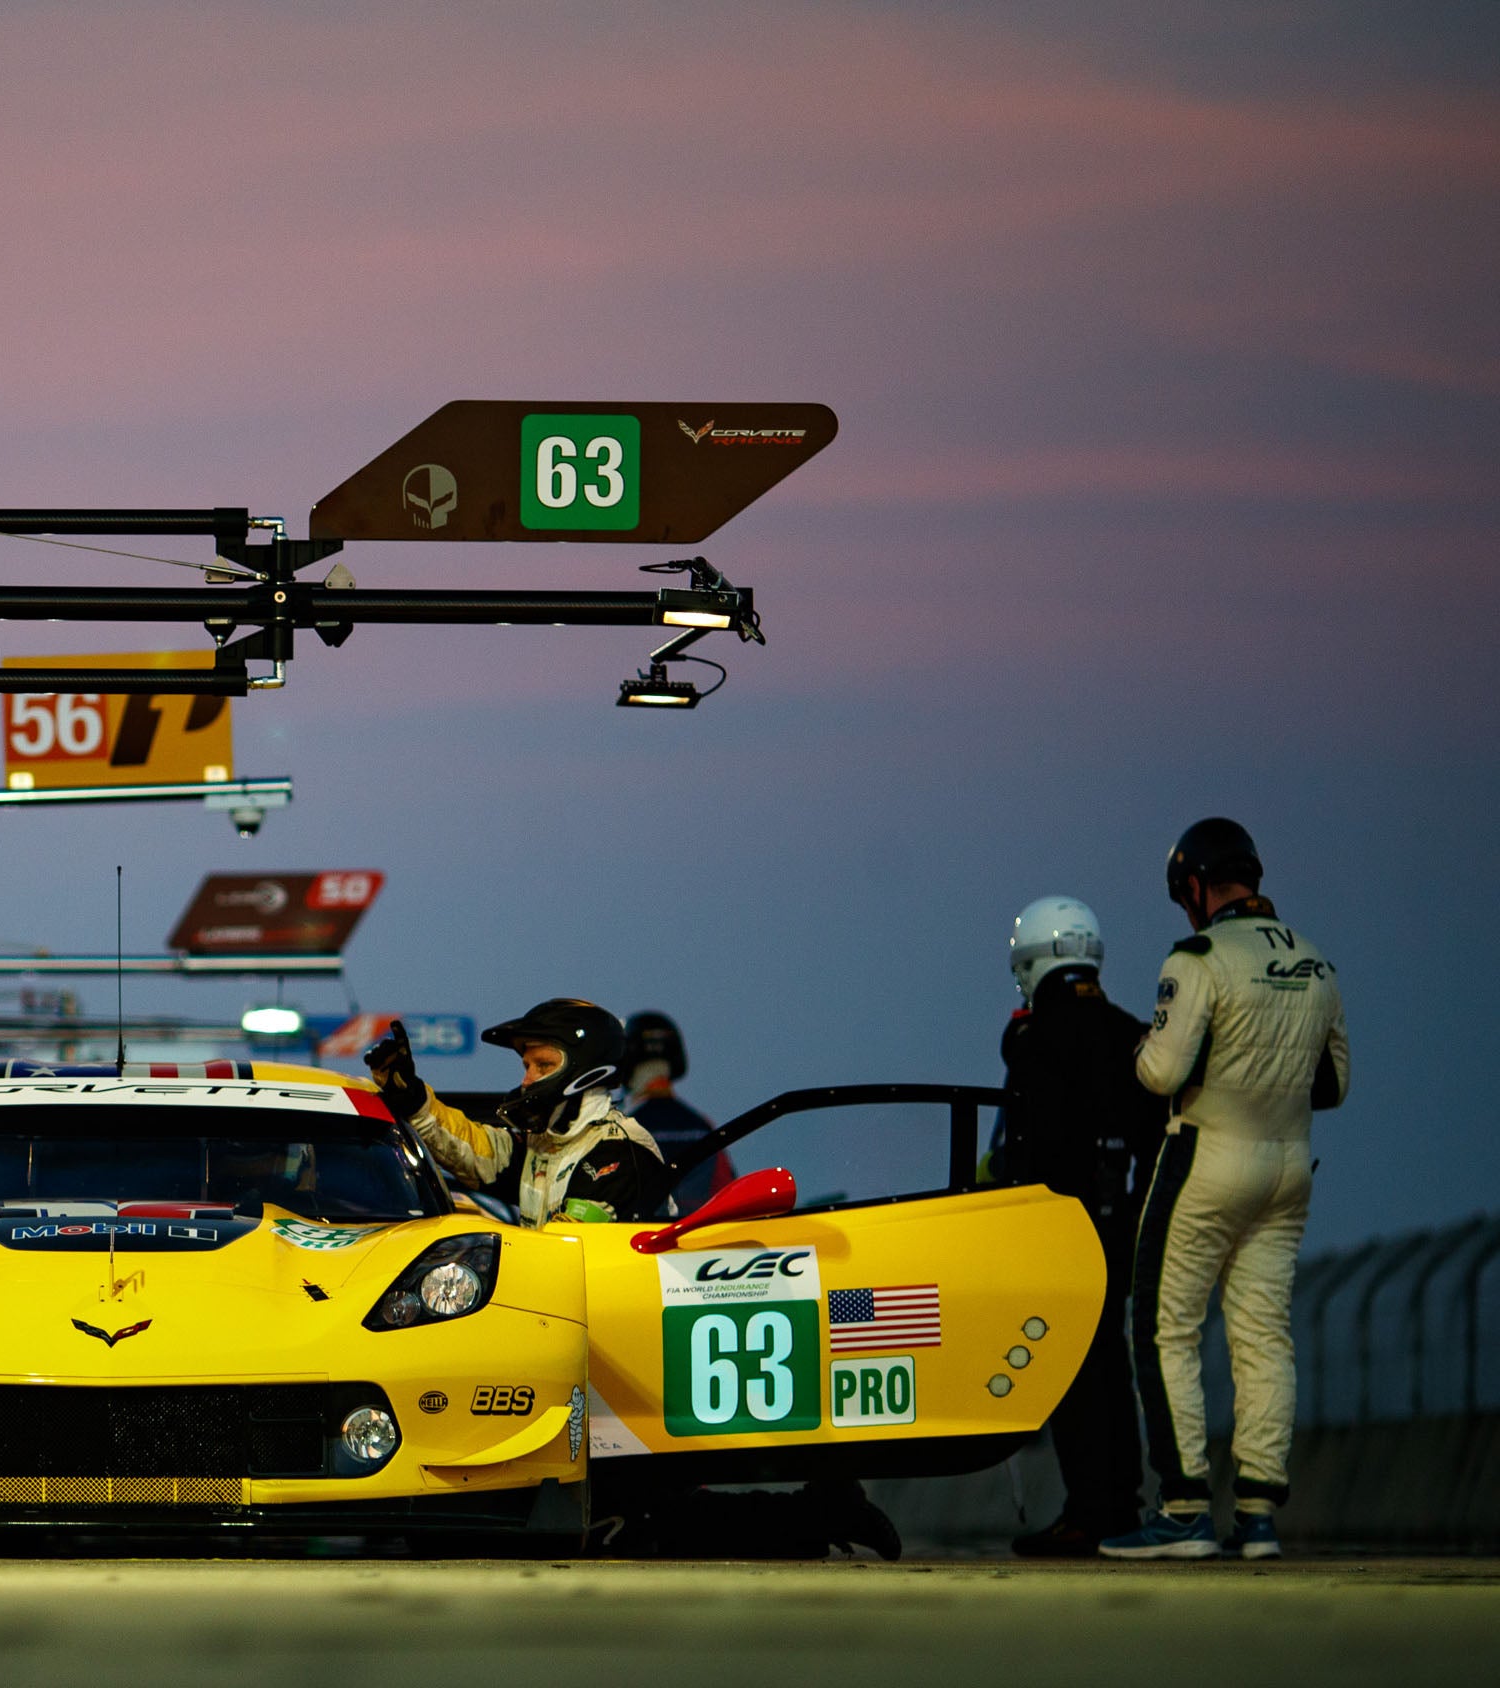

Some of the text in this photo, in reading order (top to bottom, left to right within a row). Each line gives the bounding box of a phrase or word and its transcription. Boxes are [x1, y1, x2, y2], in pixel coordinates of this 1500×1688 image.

[710, 429, 807, 437] CORVETTE
[710, 437, 803, 445] RACING
[535, 434, 626, 510] 63
[10, 692, 103, 757] 56
[1256, 927, 1294, 950] TV
[11, 1222, 218, 1242] Mobil 1
[695, 1251, 811, 1282] WEC
[666, 1282, 771, 1295] FIA WORLD ENDURANCE
[702, 1290, 769, 1300] CHAMPIONSHIP
[690, 1310, 795, 1425] 63
[420, 1396, 449, 1408] HELLA
[469, 1385, 536, 1416] BBS
[834, 1365, 912, 1417] PRO
